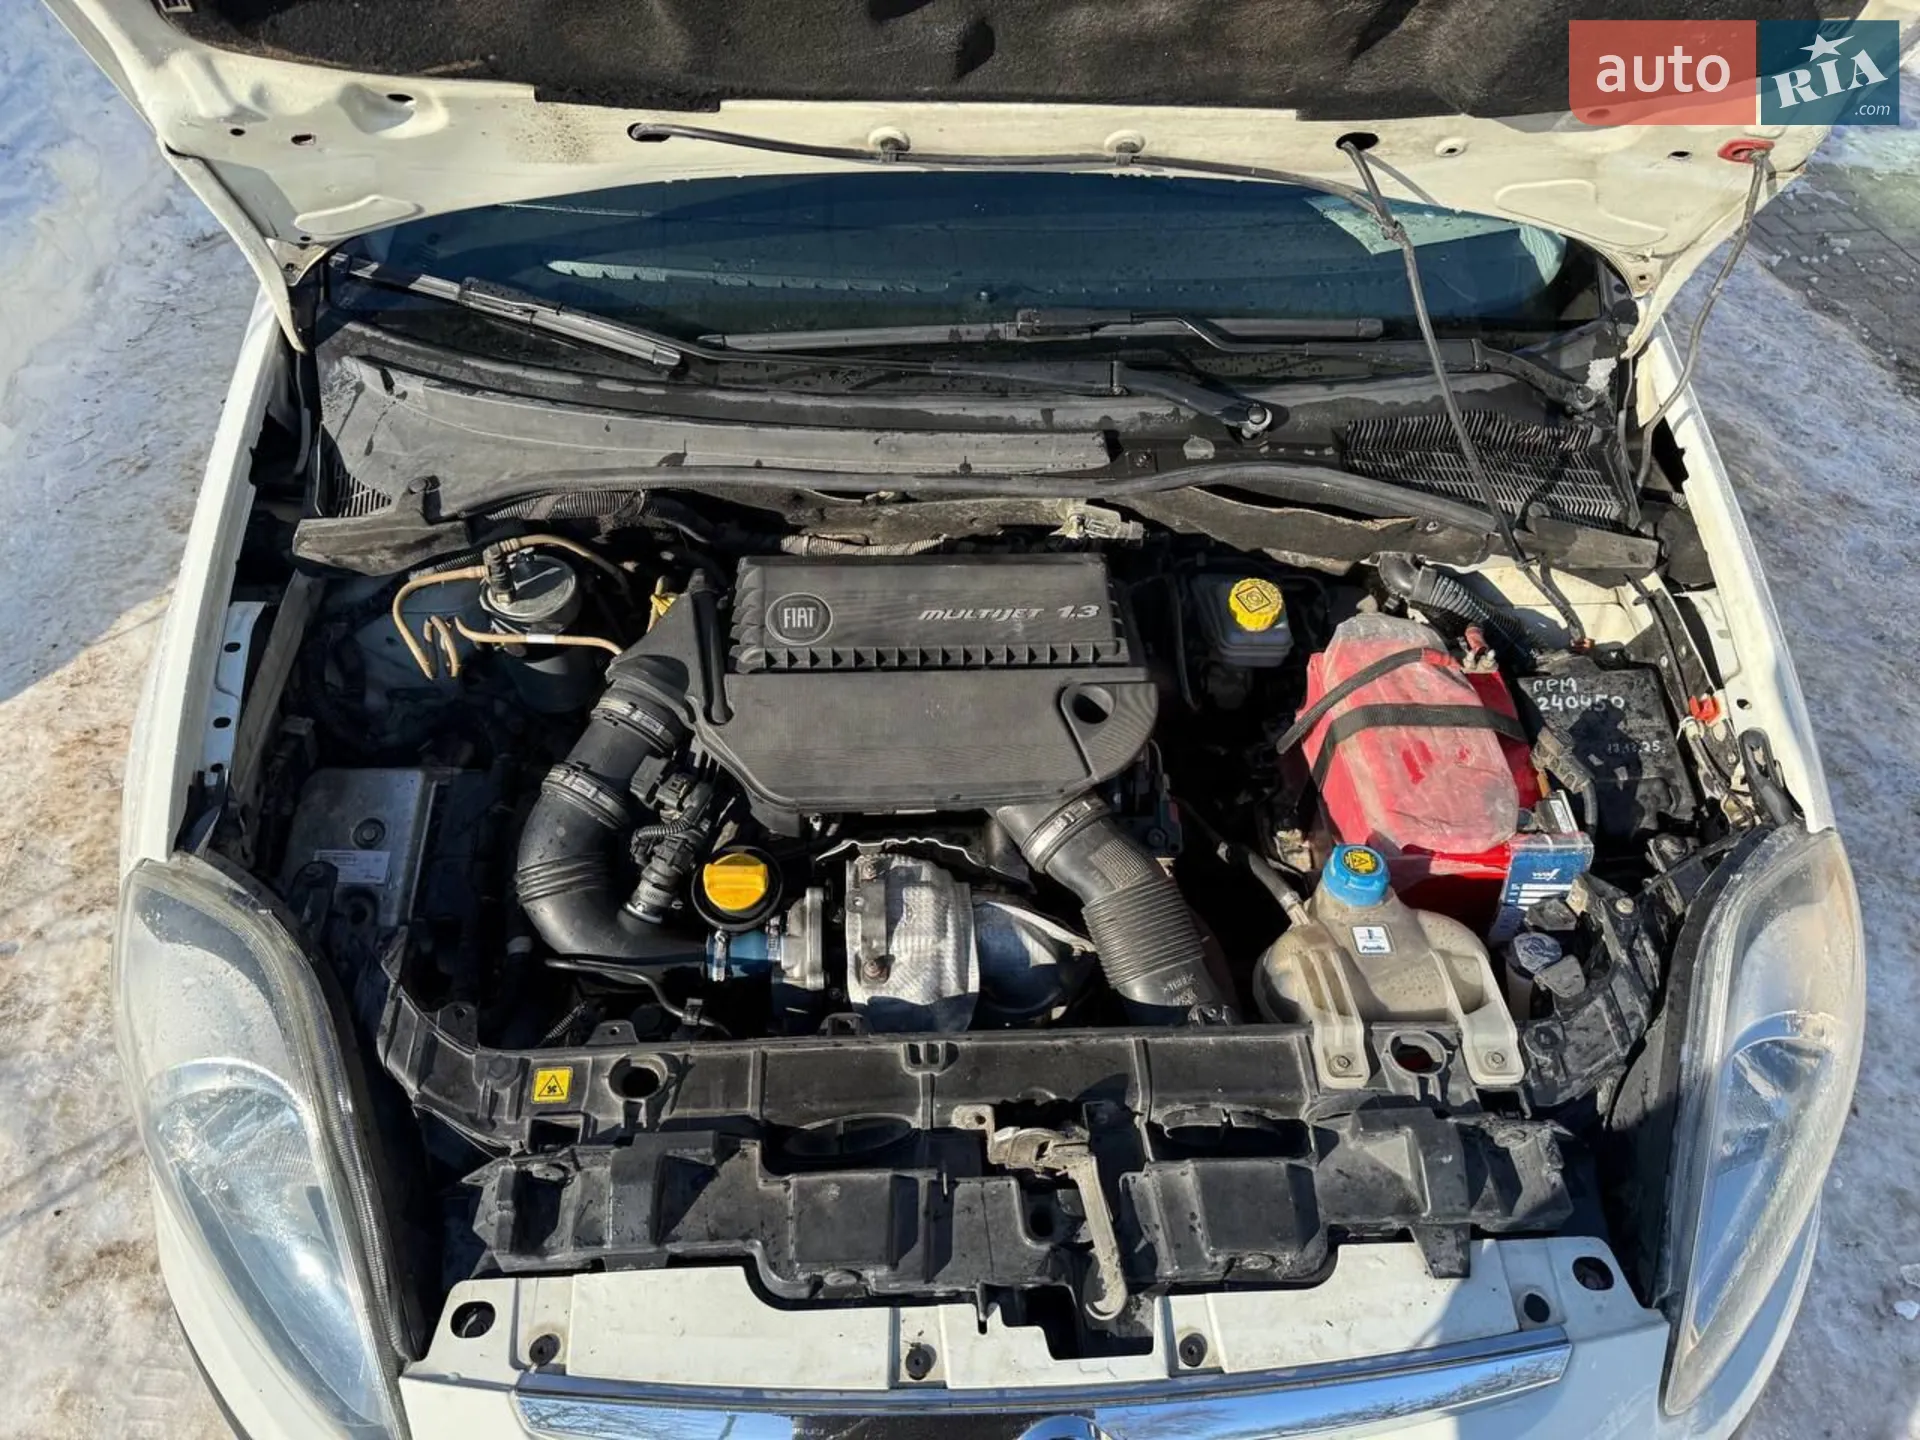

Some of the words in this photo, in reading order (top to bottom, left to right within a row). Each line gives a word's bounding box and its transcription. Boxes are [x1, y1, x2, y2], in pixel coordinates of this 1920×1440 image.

[783, 607, 816, 629] FIAT
[918, 607, 1045, 622] MULTIJET
[1057, 604, 1100, 619] 1.3
[1537, 694, 1625, 711] 240450
